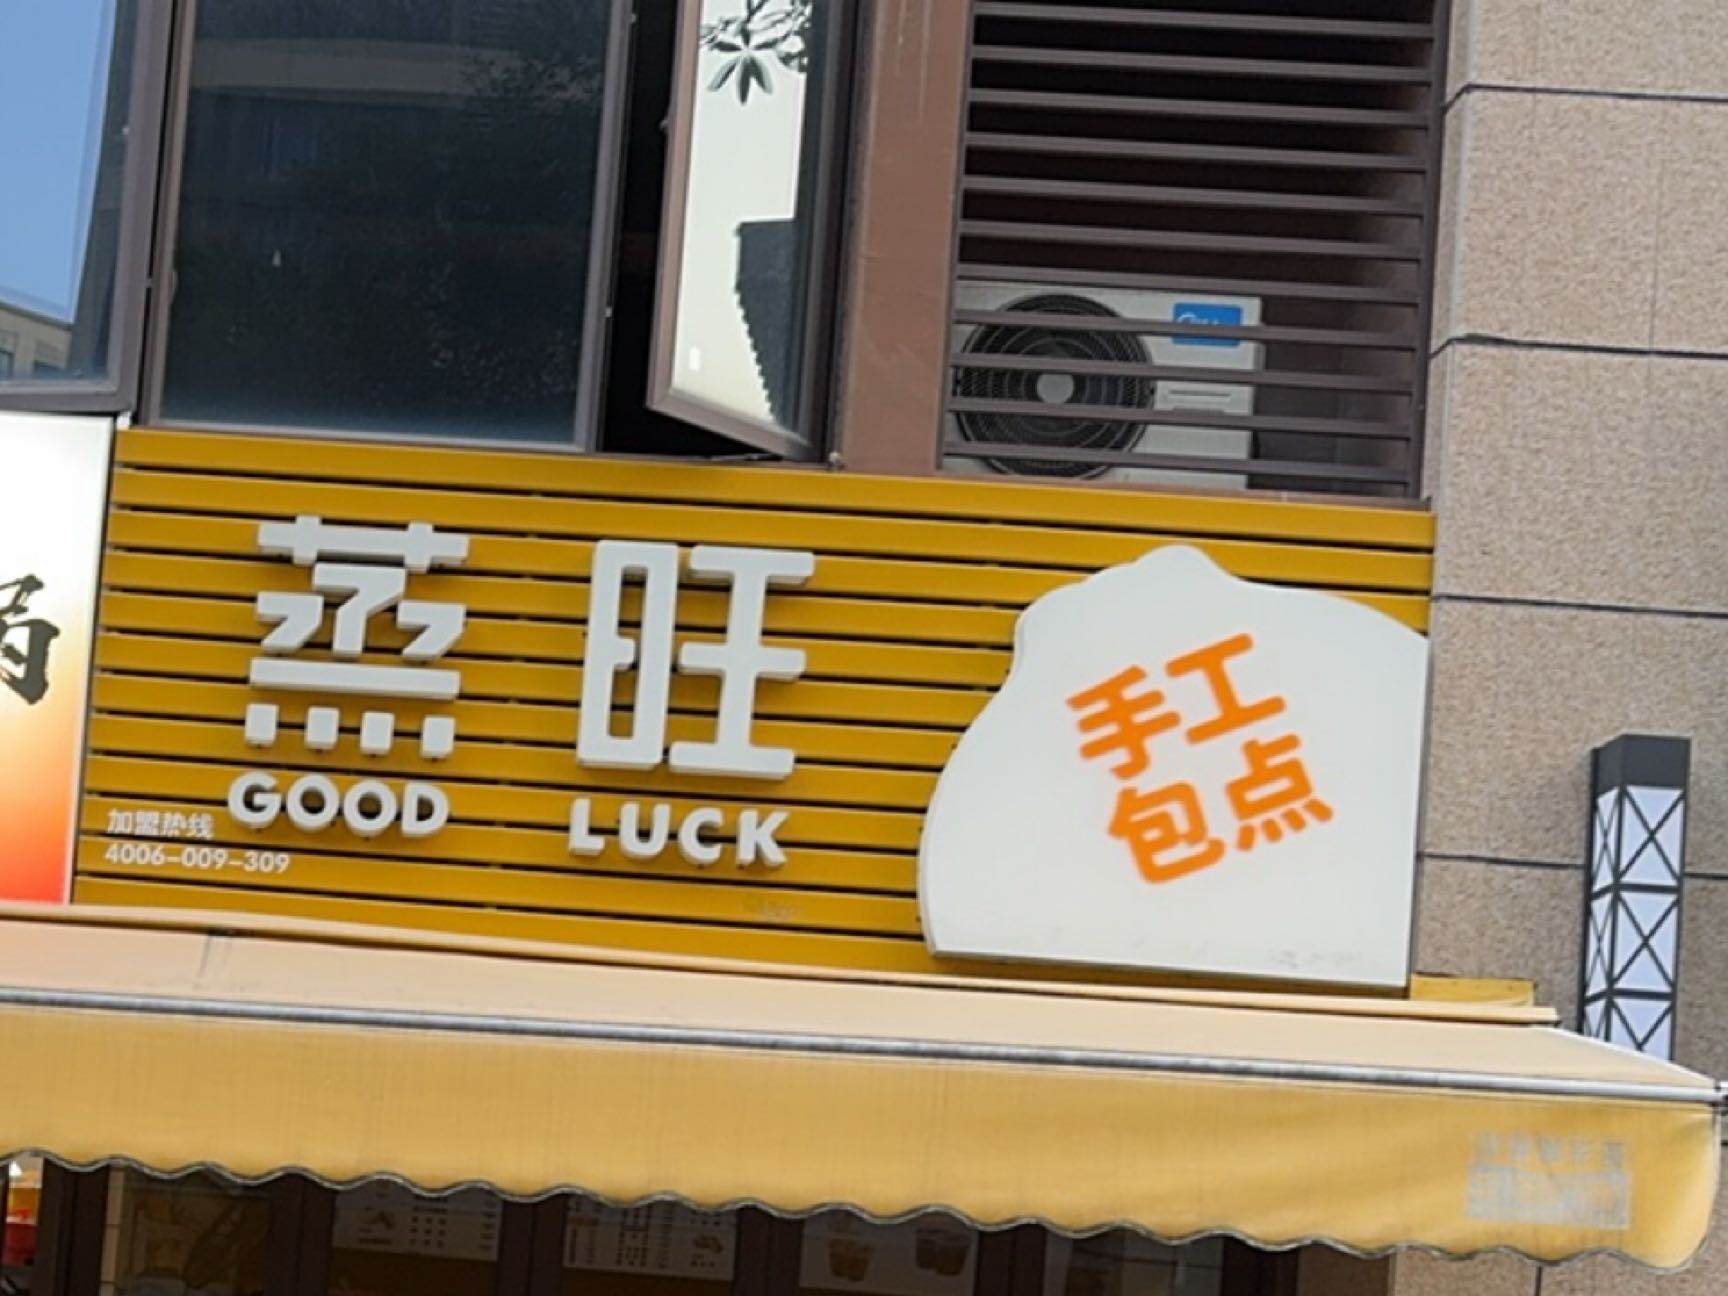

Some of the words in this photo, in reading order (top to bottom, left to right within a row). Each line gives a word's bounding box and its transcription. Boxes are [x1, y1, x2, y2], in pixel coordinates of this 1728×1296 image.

[244, 515, 815, 780] 蒸旺
[1066, 633, 1287, 779] 手工
[105, 842, 291, 875] 4006-009-309
[107, 808, 215, 840] 加盟热线
[226, 772, 451, 839] GOOD
[568, 798, 790, 867] LUCK
[1106, 732, 1334, 885] 包点
